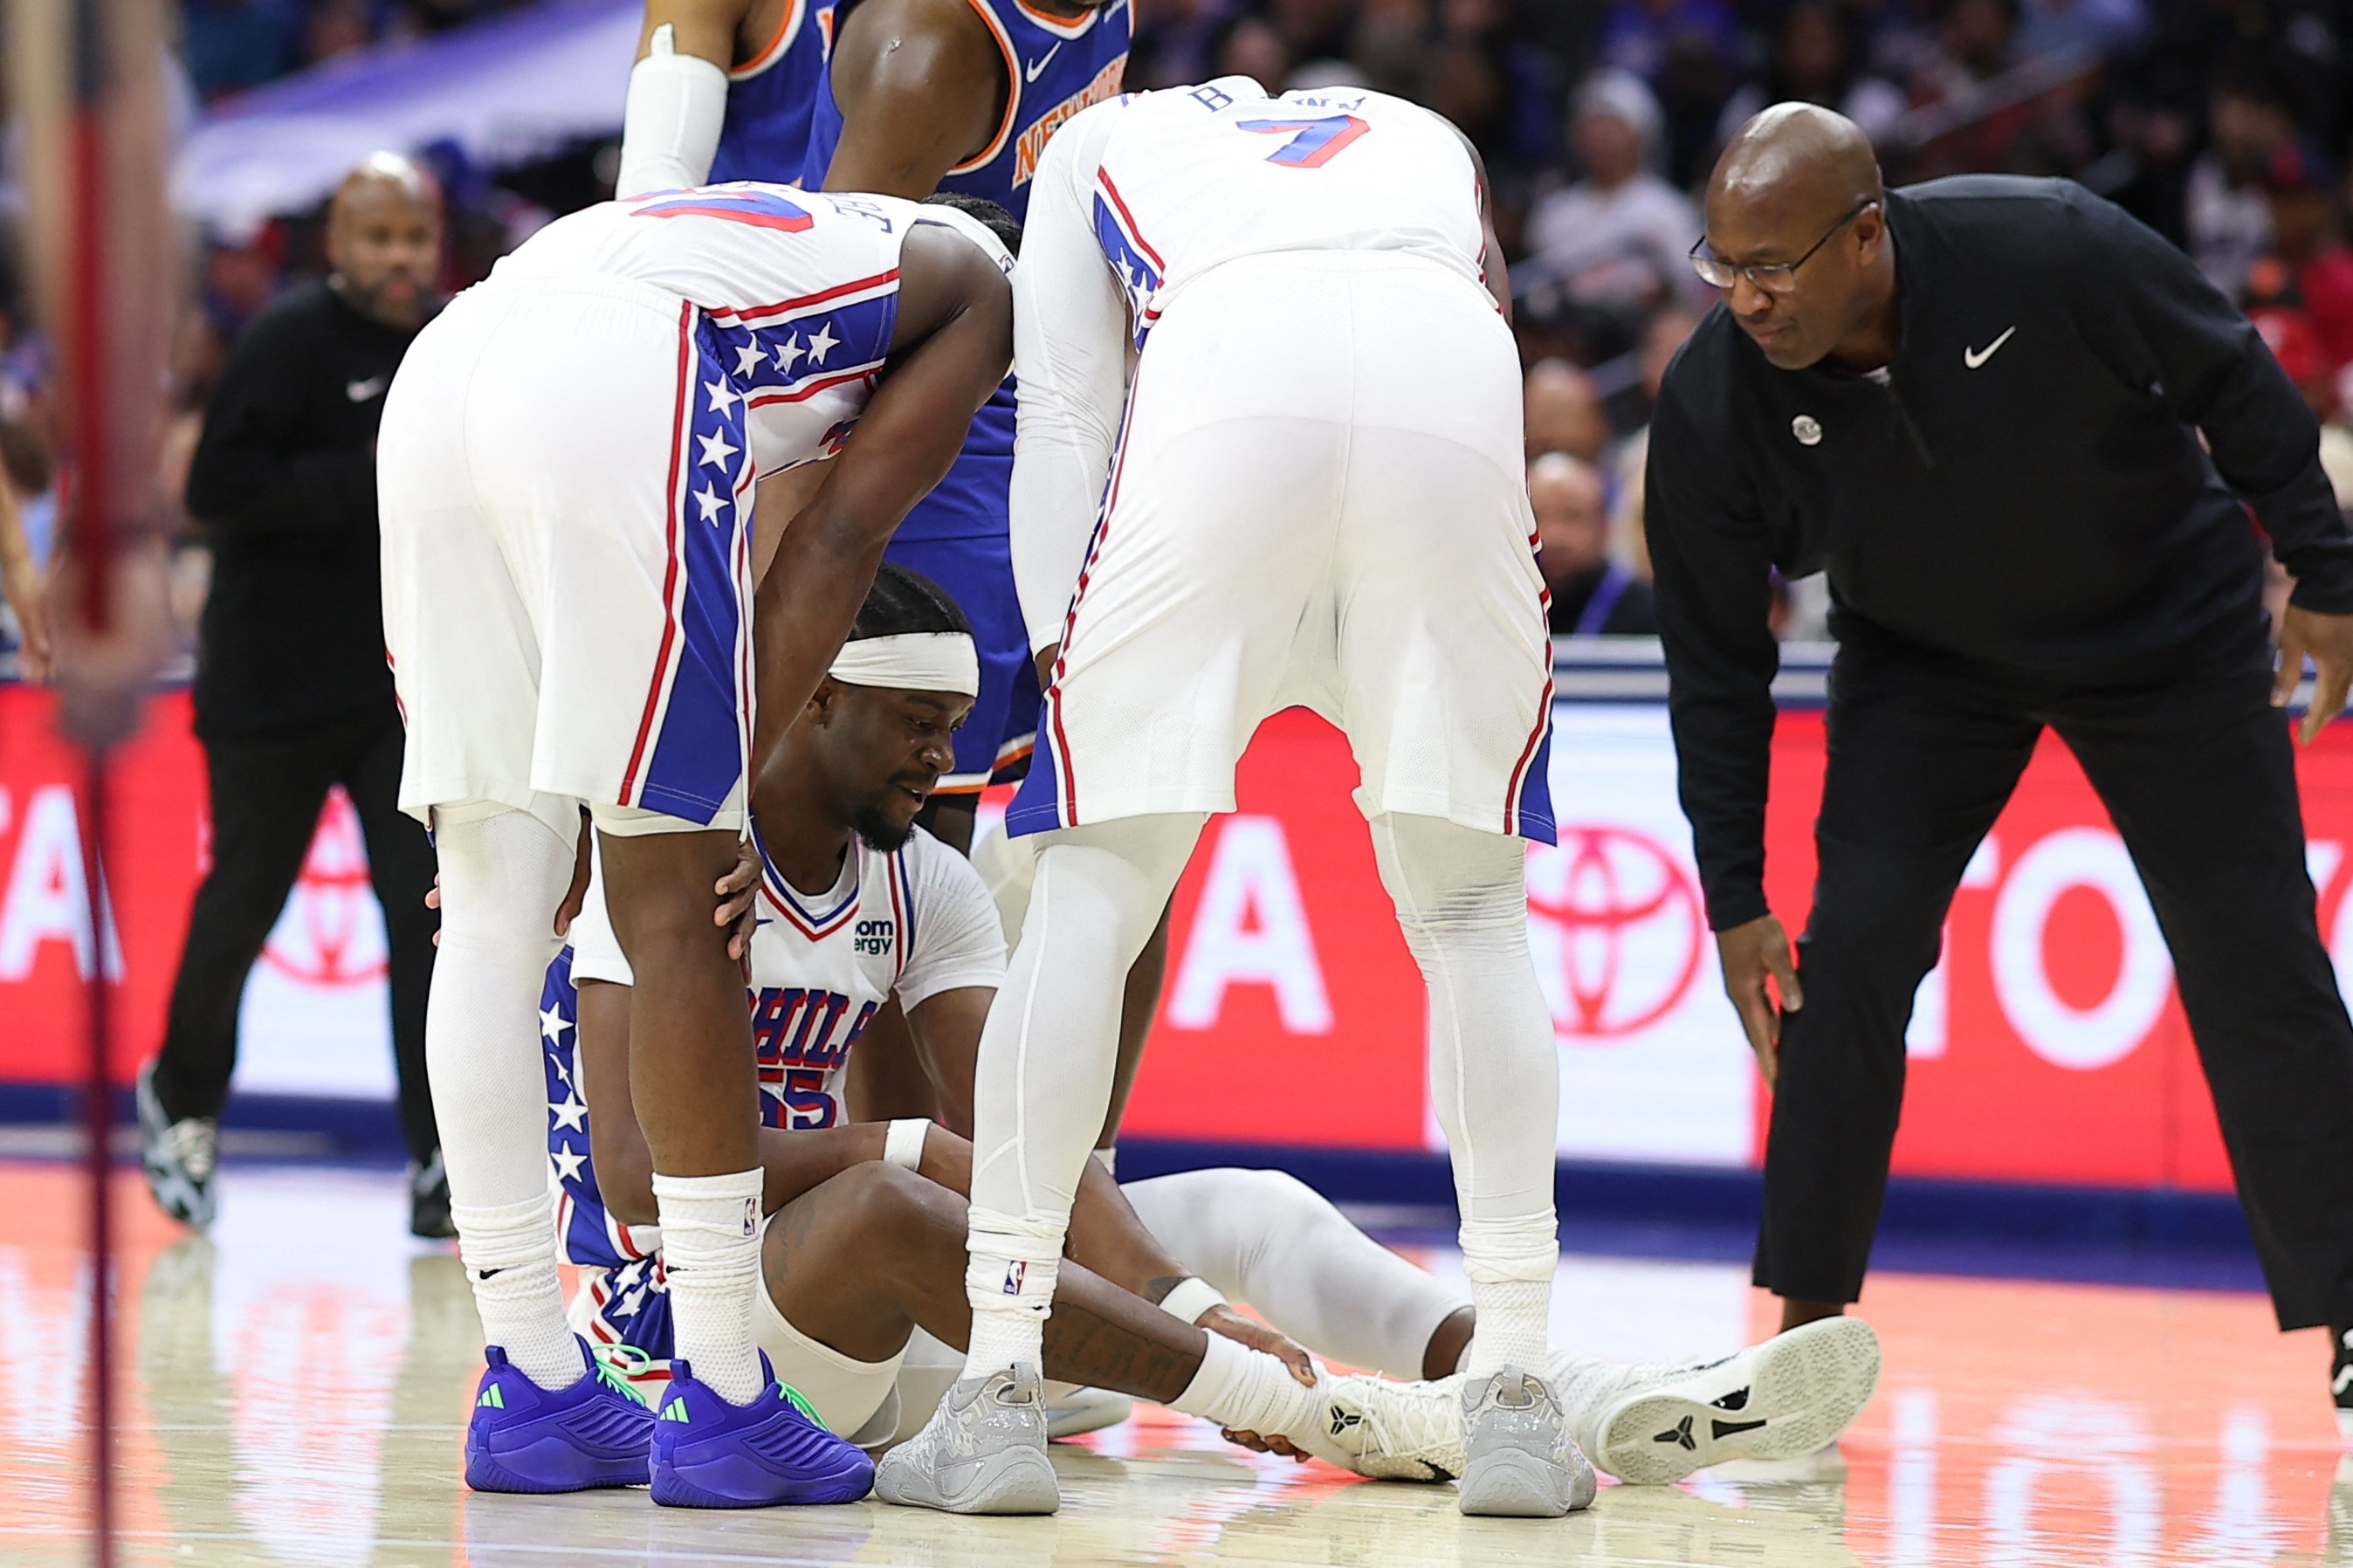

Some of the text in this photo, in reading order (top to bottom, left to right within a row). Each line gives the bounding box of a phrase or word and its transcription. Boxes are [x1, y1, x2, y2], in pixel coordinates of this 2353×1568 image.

[1235, 114, 1371, 168] 7
[855, 920, 893, 936] om
[746, 987, 877, 1071] HILA
